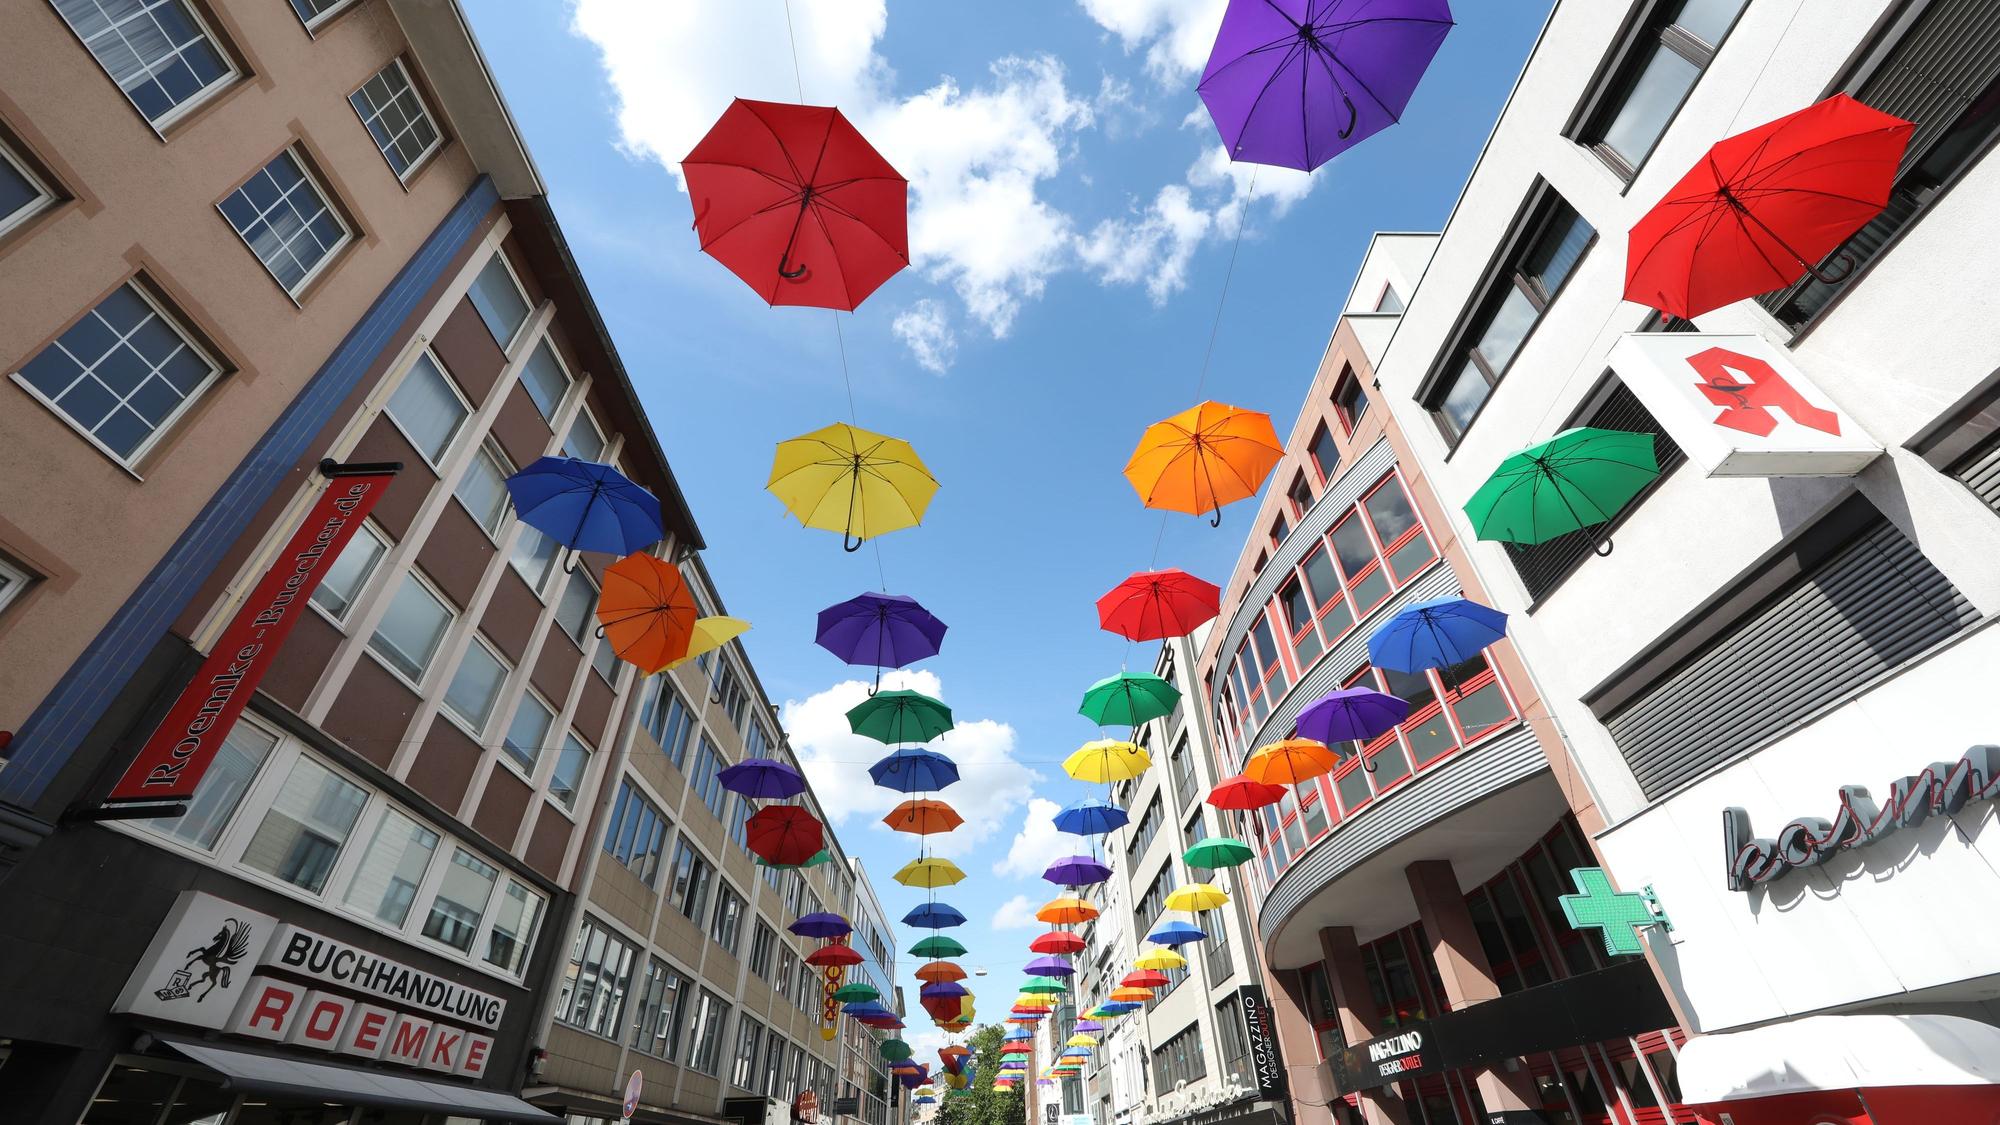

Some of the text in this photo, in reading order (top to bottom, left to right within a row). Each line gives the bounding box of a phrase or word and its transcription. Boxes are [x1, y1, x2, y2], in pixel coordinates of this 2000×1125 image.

[172, 977, 182, 987] R
[281, 932, 500, 1025] BUCHHANDLUNG
[248, 986, 488, 1072] ROEMKE
[1245, 996, 1272, 1089] MAGAZZINO
[1368, 1031, 1421, 1063] MAGAZZINO
